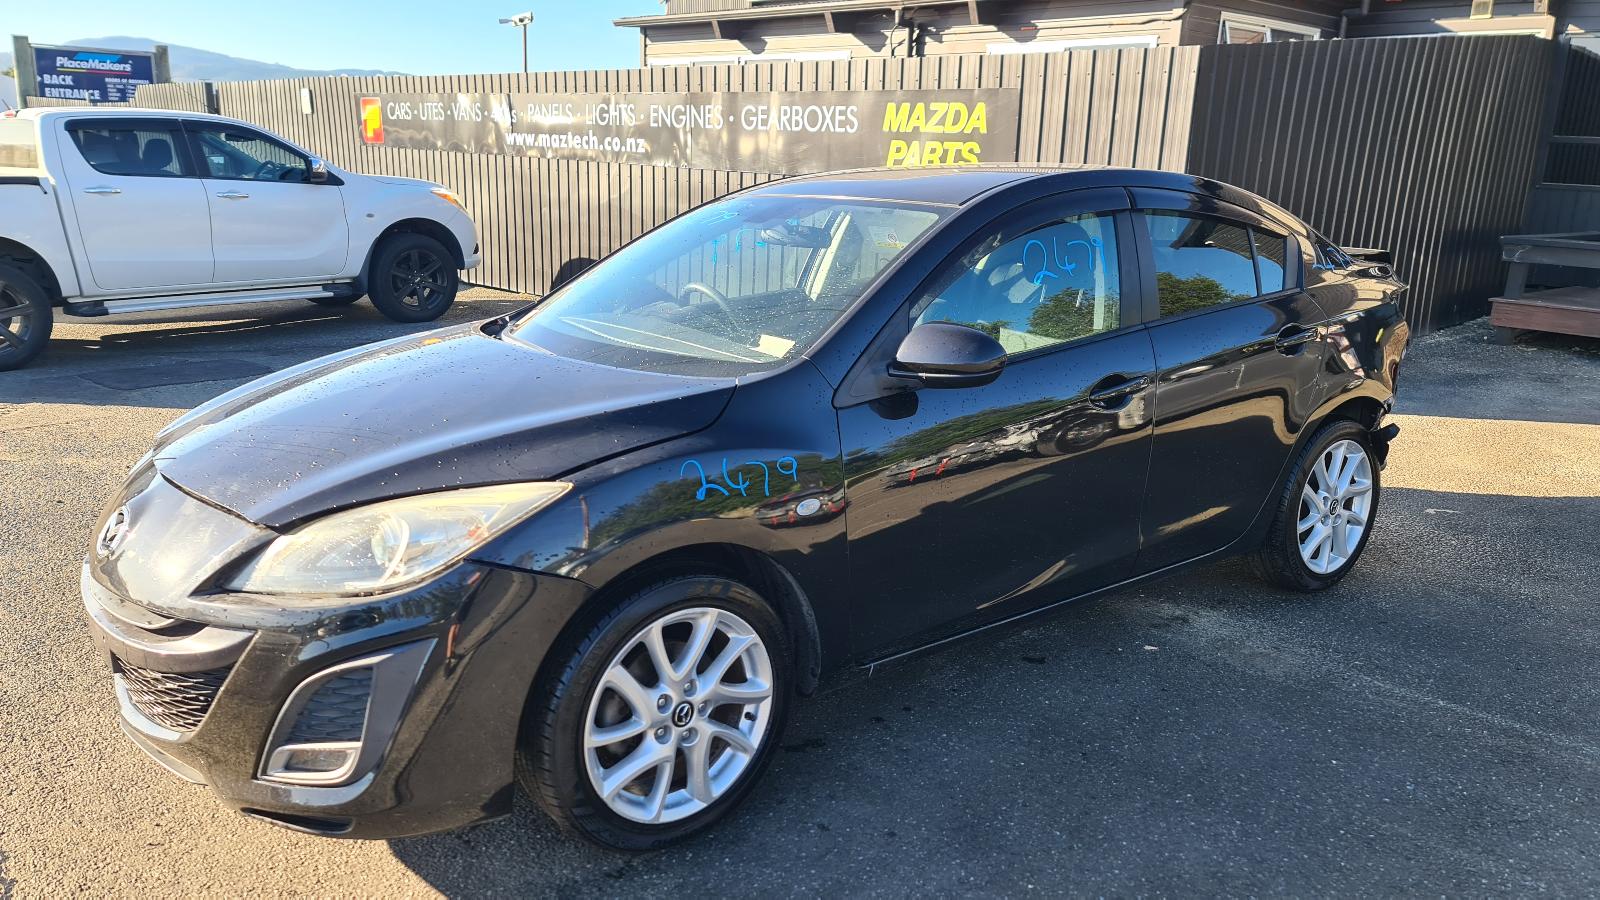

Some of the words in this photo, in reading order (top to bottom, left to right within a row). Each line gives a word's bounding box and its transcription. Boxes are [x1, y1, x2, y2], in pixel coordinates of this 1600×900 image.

[56, 56, 131, 71] PlaceMakers
[43, 74, 74, 85] BACK
[45, 87, 100, 99] ENTRANCE
[387, 102, 412, 120] CARS
[420, 103, 444, 121] UTES
[451, 102, 482, 122] VANS
[528, 103, 573, 124] PANELS
[585, 103, 636, 127] LIGHTS
[650, 104, 723, 129] ENGINES
[741, 104, 859, 133] GEARBOXES
[882, 102, 988, 134] MAZDA
[505, 130, 646, 153] www.maztech.co.nz
[886, 139, 981, 169] PARTS
[1022, 236, 1107, 285] 2479
[680, 456, 798, 501] 2479
